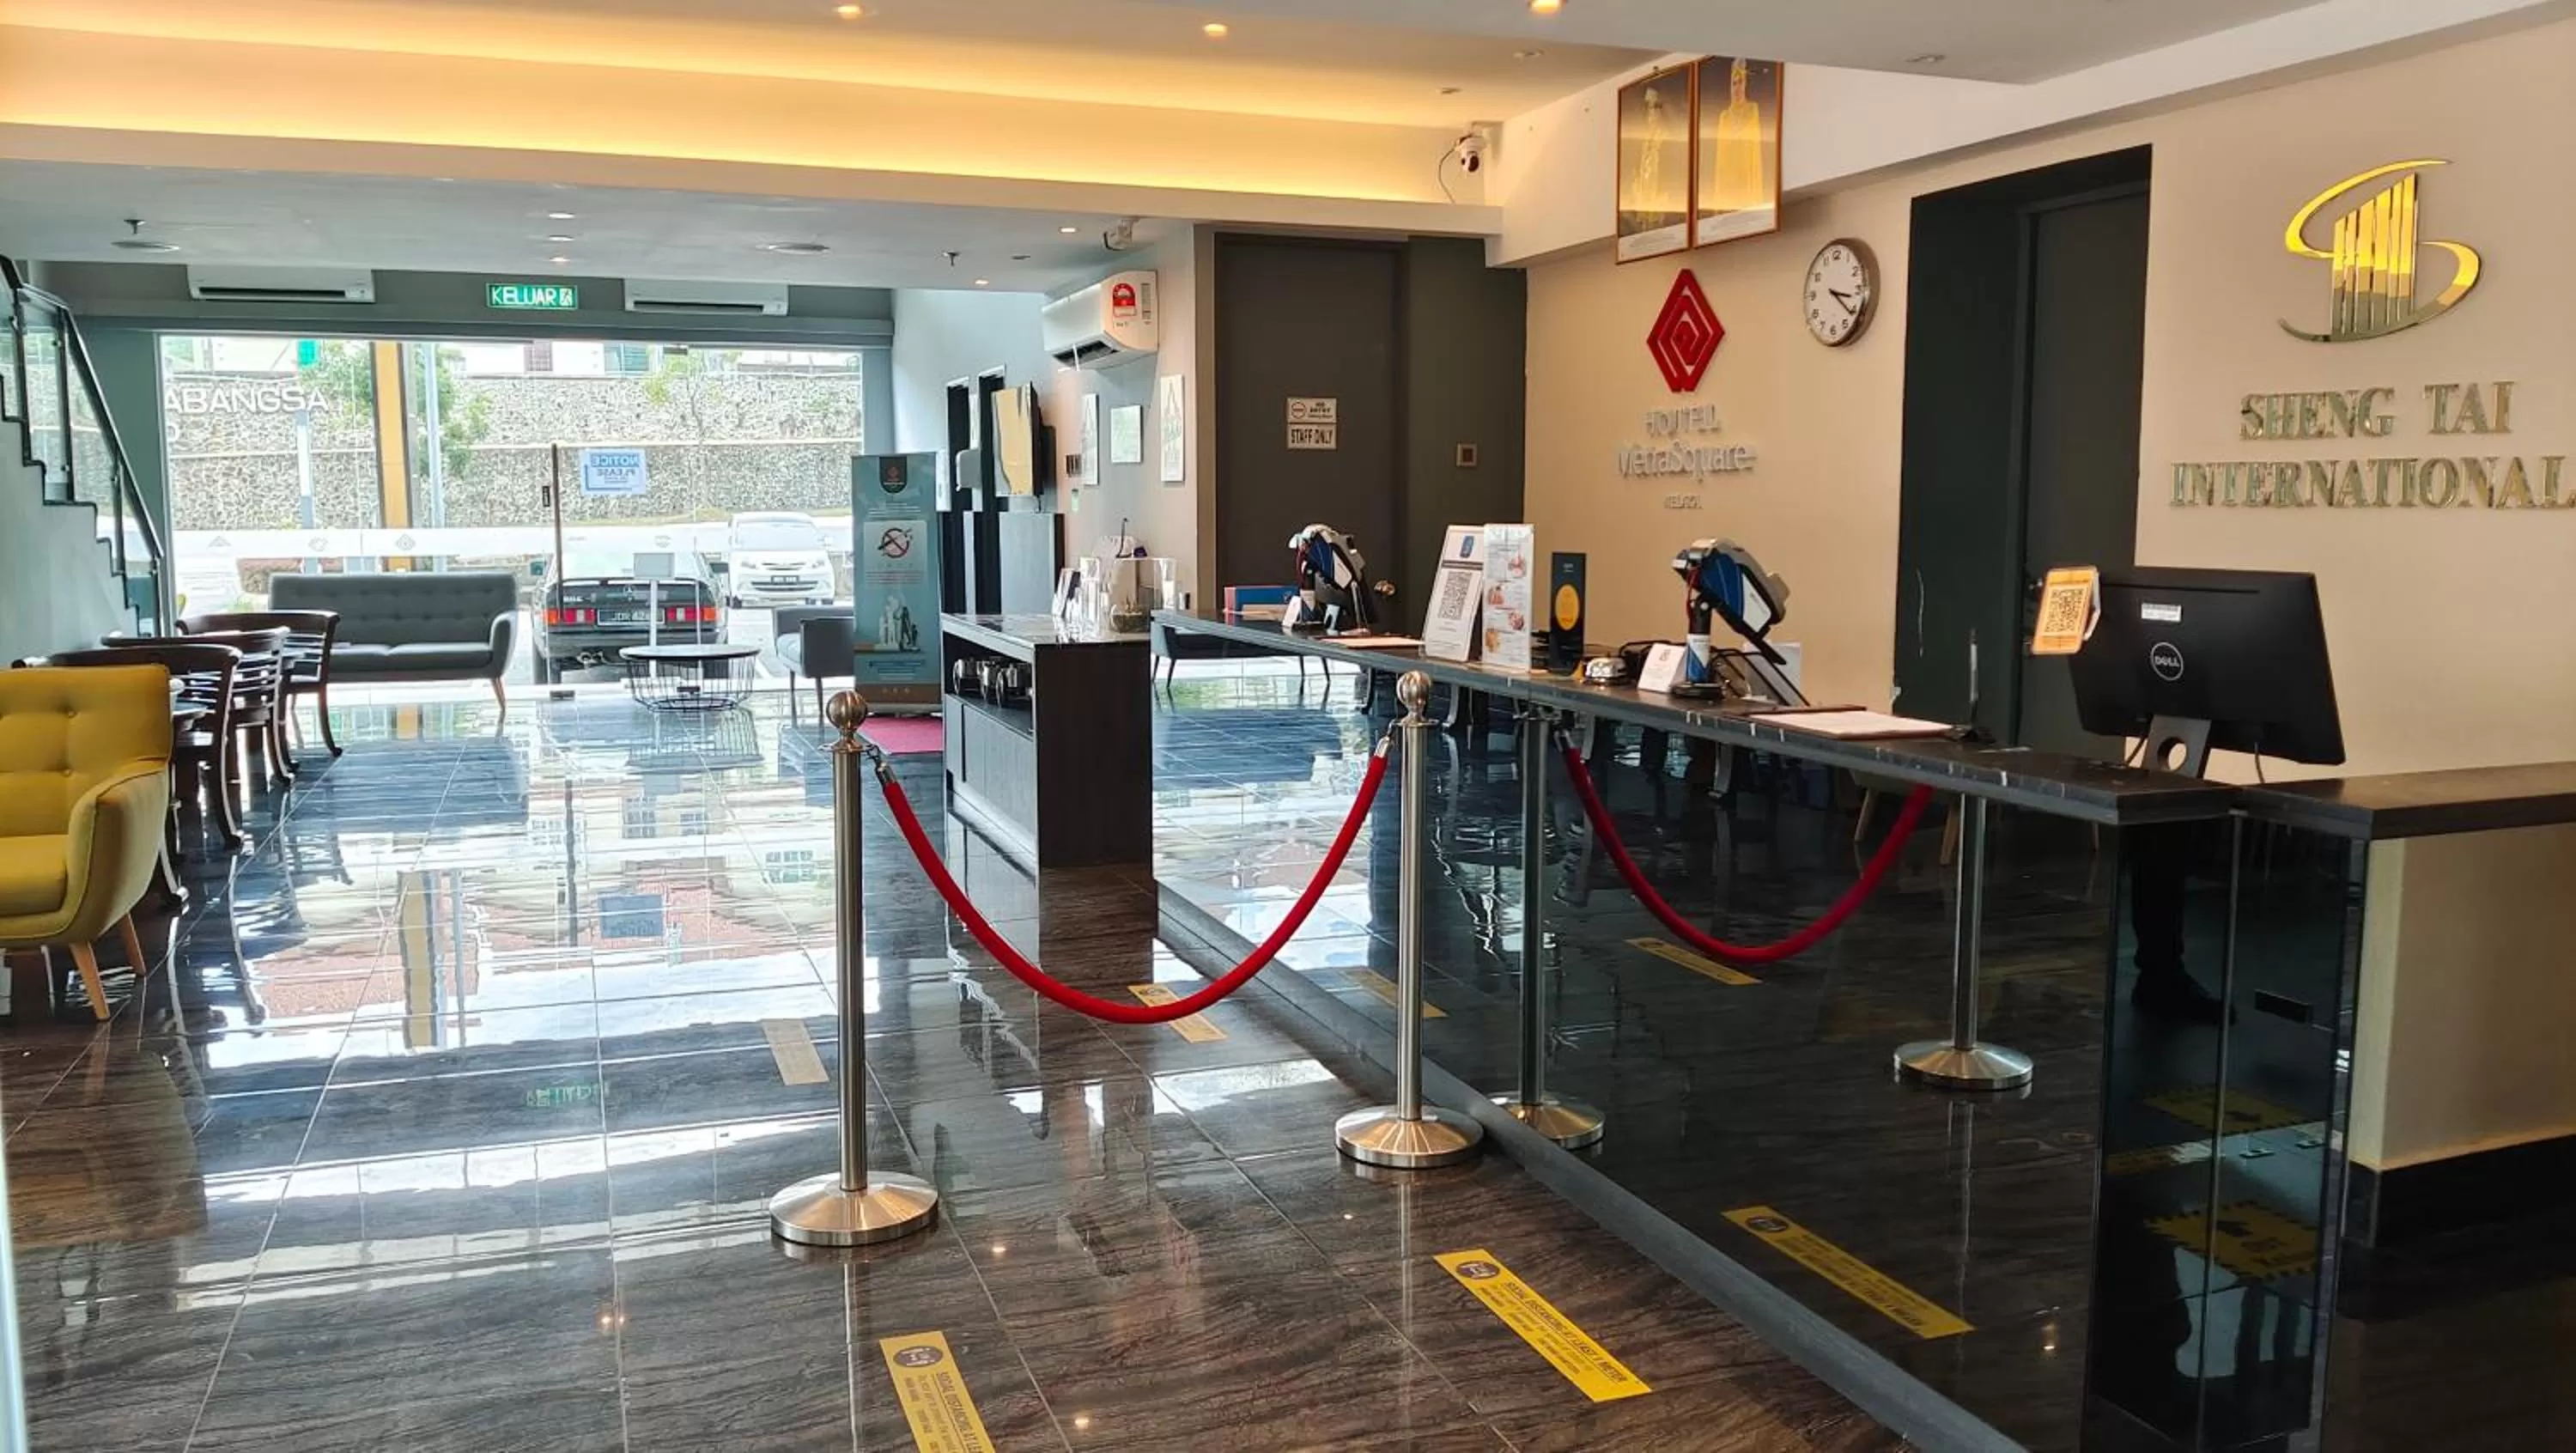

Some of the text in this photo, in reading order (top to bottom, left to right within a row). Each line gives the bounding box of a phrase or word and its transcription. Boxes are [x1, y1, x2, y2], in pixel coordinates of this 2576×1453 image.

[491, 286, 557, 307] KELUAR
[2239, 380, 2517, 441] SHENG TAI
[1291, 429, 1333, 444] STAFF ONLY
[2168, 455, 2576, 509] INTERNATIONAL
[2154, 655, 2180, 667] DELL
